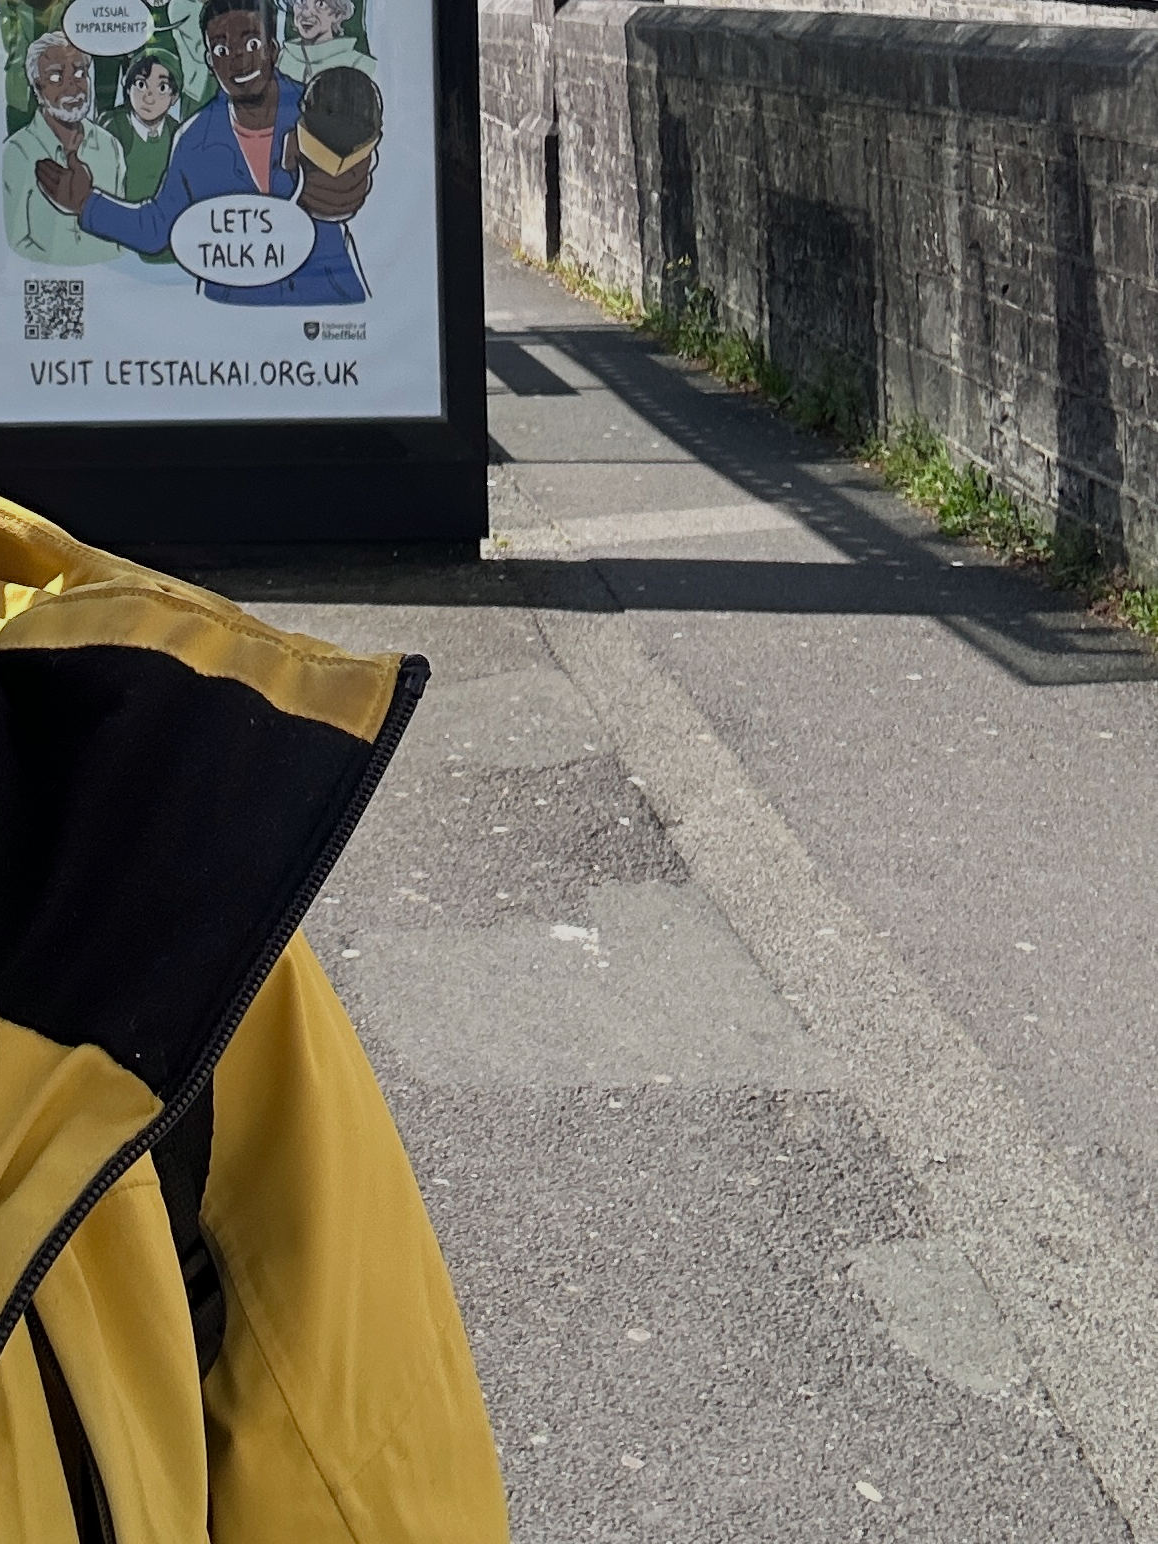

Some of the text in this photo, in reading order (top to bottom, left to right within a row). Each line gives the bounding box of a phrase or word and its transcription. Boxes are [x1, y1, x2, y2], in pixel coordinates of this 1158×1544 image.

[91, 5, 130, 18] VISUAL
[75, 21, 148, 34] IMPAIRMENT?
[210, 208, 273, 234] LET'S
[197, 242, 285, 269] TALK AI
[29, 359, 359, 387] VISIT LETSTALKAI.ORG.UK
